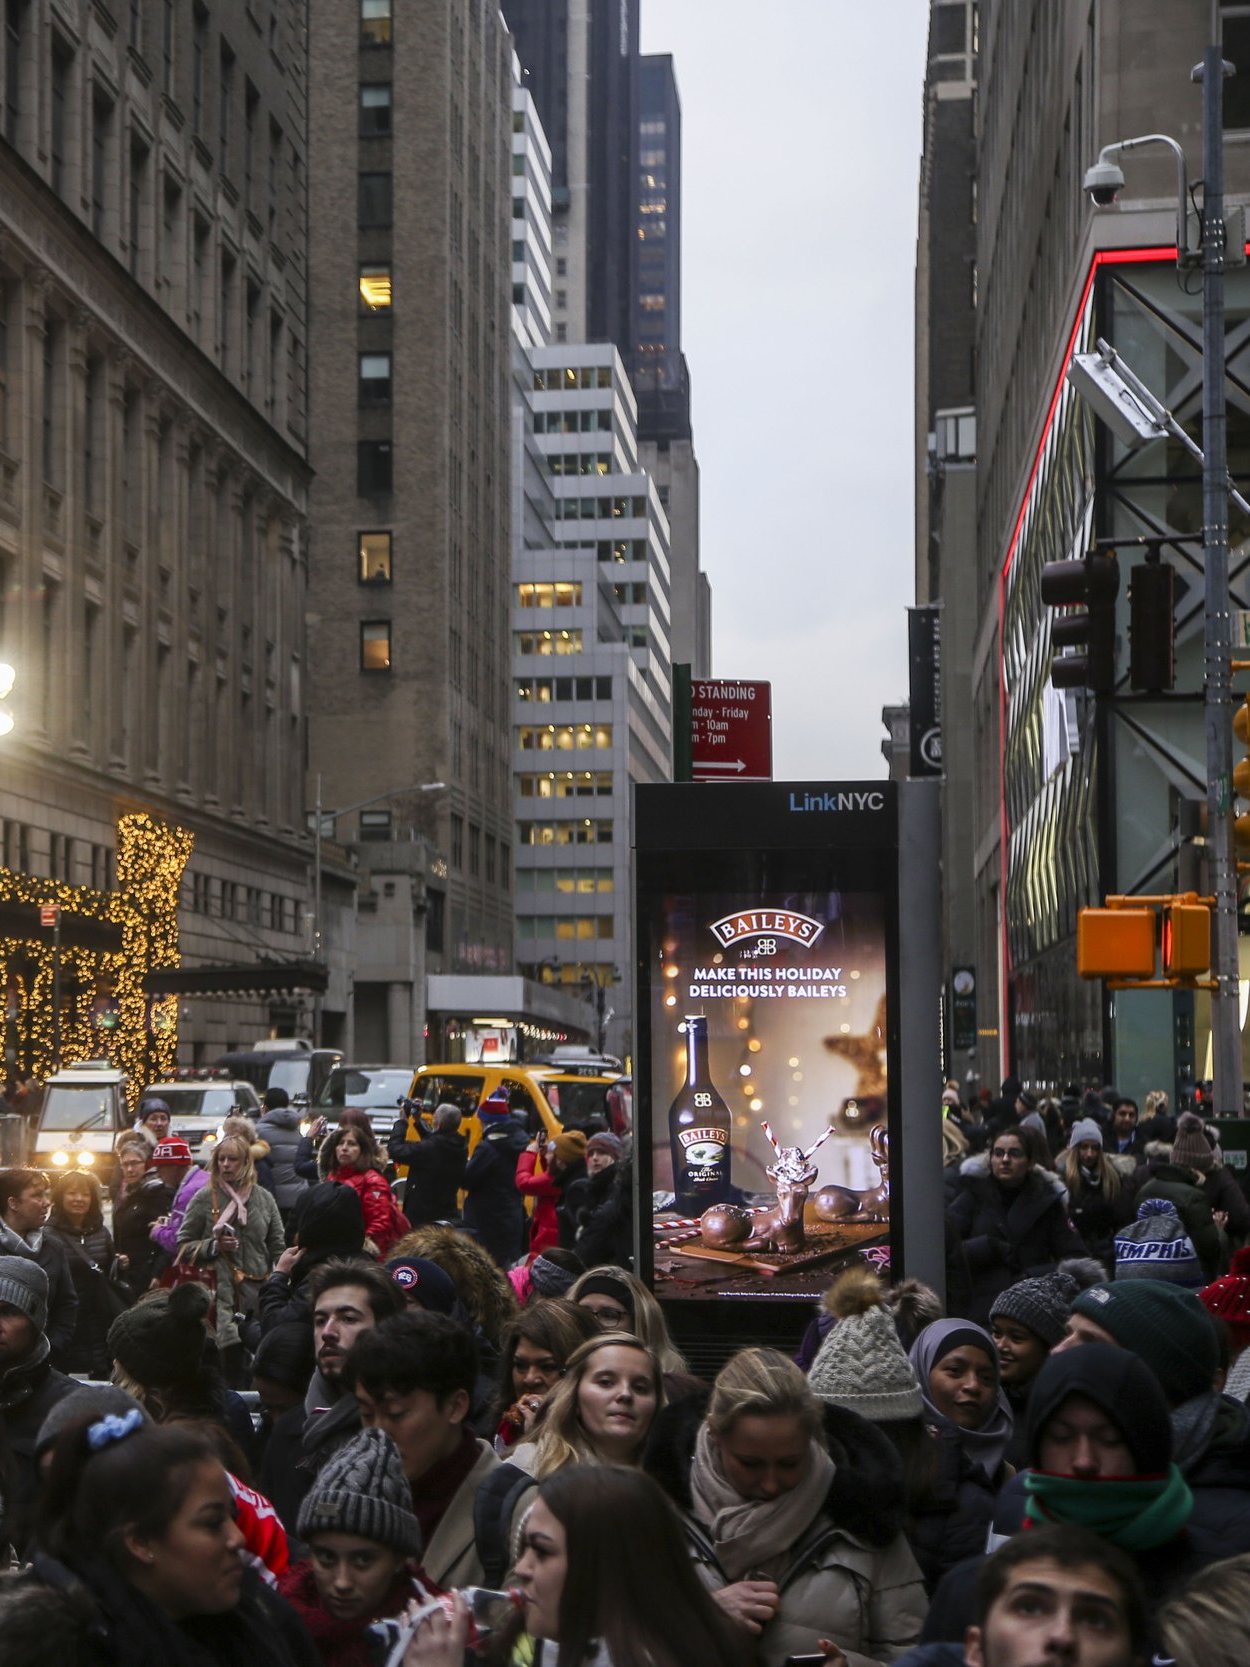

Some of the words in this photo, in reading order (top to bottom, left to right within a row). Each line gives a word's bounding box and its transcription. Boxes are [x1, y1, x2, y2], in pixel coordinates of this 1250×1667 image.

[699, 685, 755, 700] STANDING
[692, 706, 713, 718] nday
[722, 707, 749, 720] Friday
[707, 720, 728, 730] 10am
[707, 733, 726, 745] 7pm
[790, 793, 884, 811] LinkNYC
[720, 914, 813, 939] BAILEYS
[694, 968, 736, 980] MAKE
[738, 968, 772, 980] THIS
[775, 968, 842, 980] HOLIDAY
[689, 985, 785, 998] DELICIOUSLY
[788, 985, 847, 998] BAILEYS
[682, 1130, 725, 1143] BAILEYS
